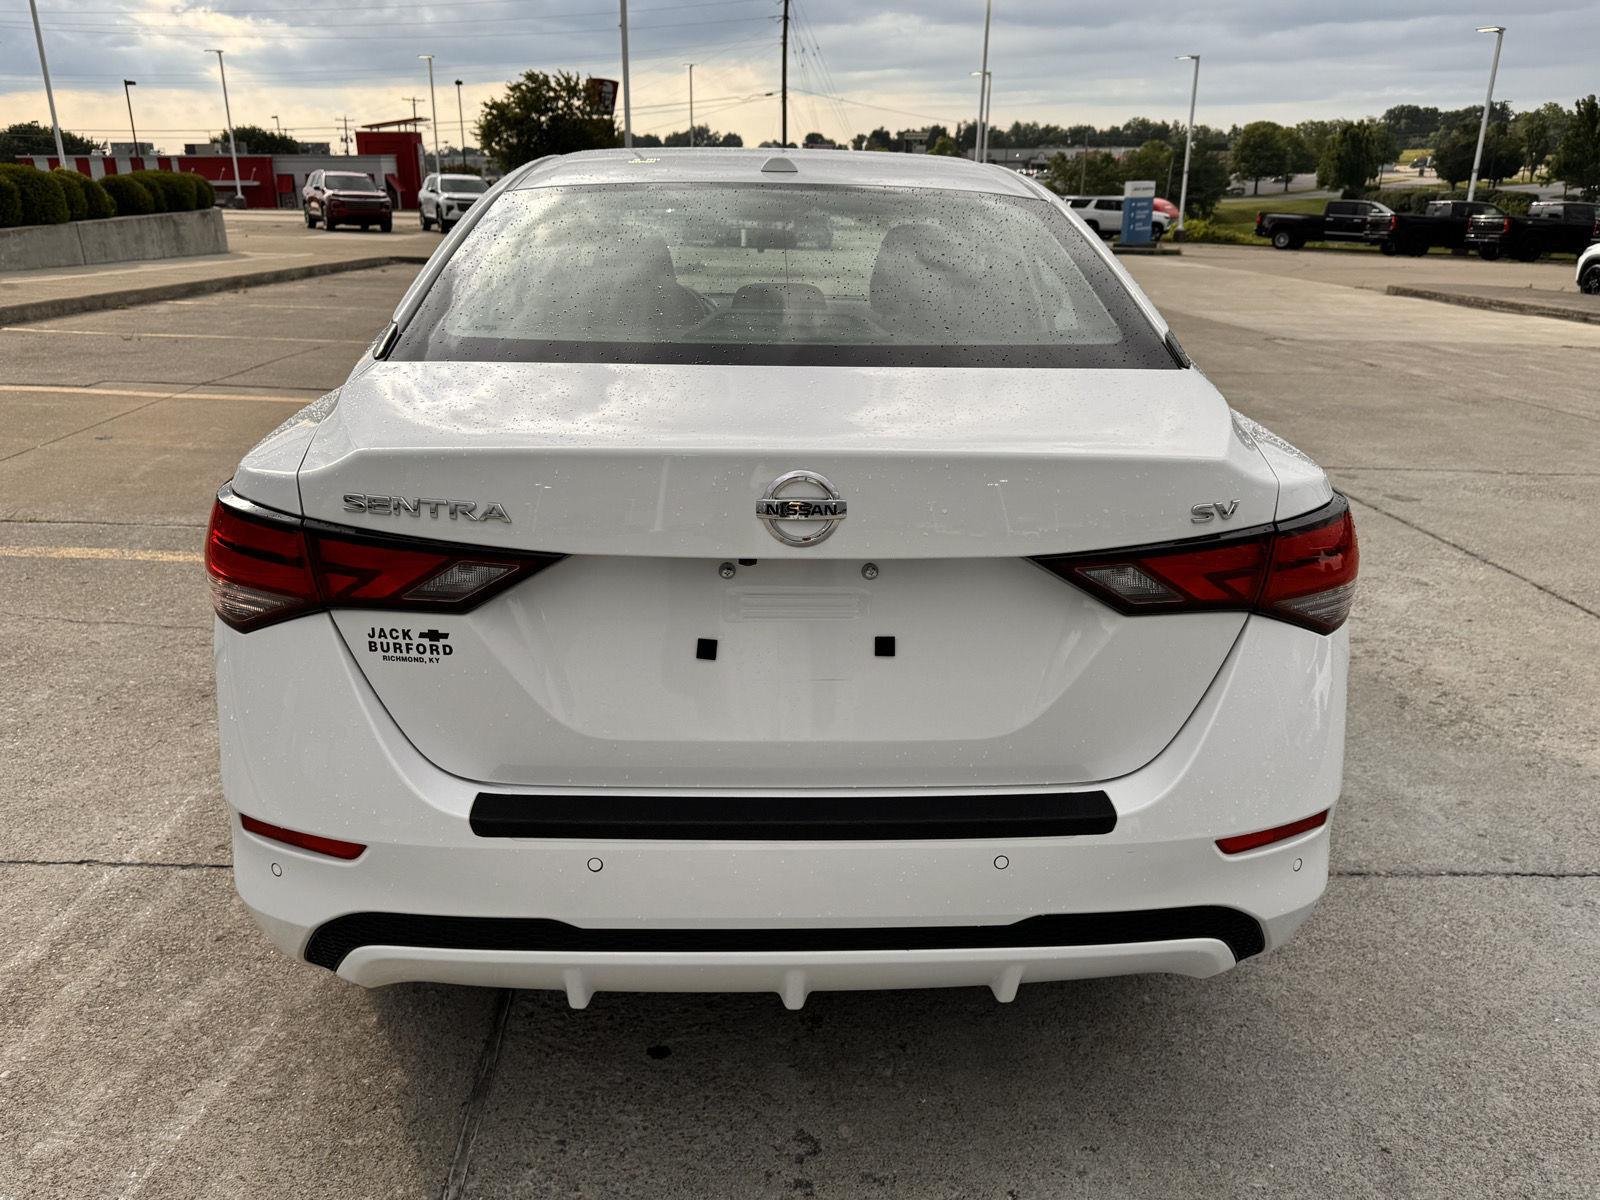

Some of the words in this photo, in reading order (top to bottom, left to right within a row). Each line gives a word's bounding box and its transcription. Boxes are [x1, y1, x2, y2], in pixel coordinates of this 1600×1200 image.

[342, 493, 512, 524] SENTRA
[766, 503, 838, 517] NISSAN
[1190, 499, 1241, 524] SV
[367, 627, 414, 641] JACK
[368, 640, 454, 656] BURFORD
[382, 655, 427, 664] RICHMOND,
